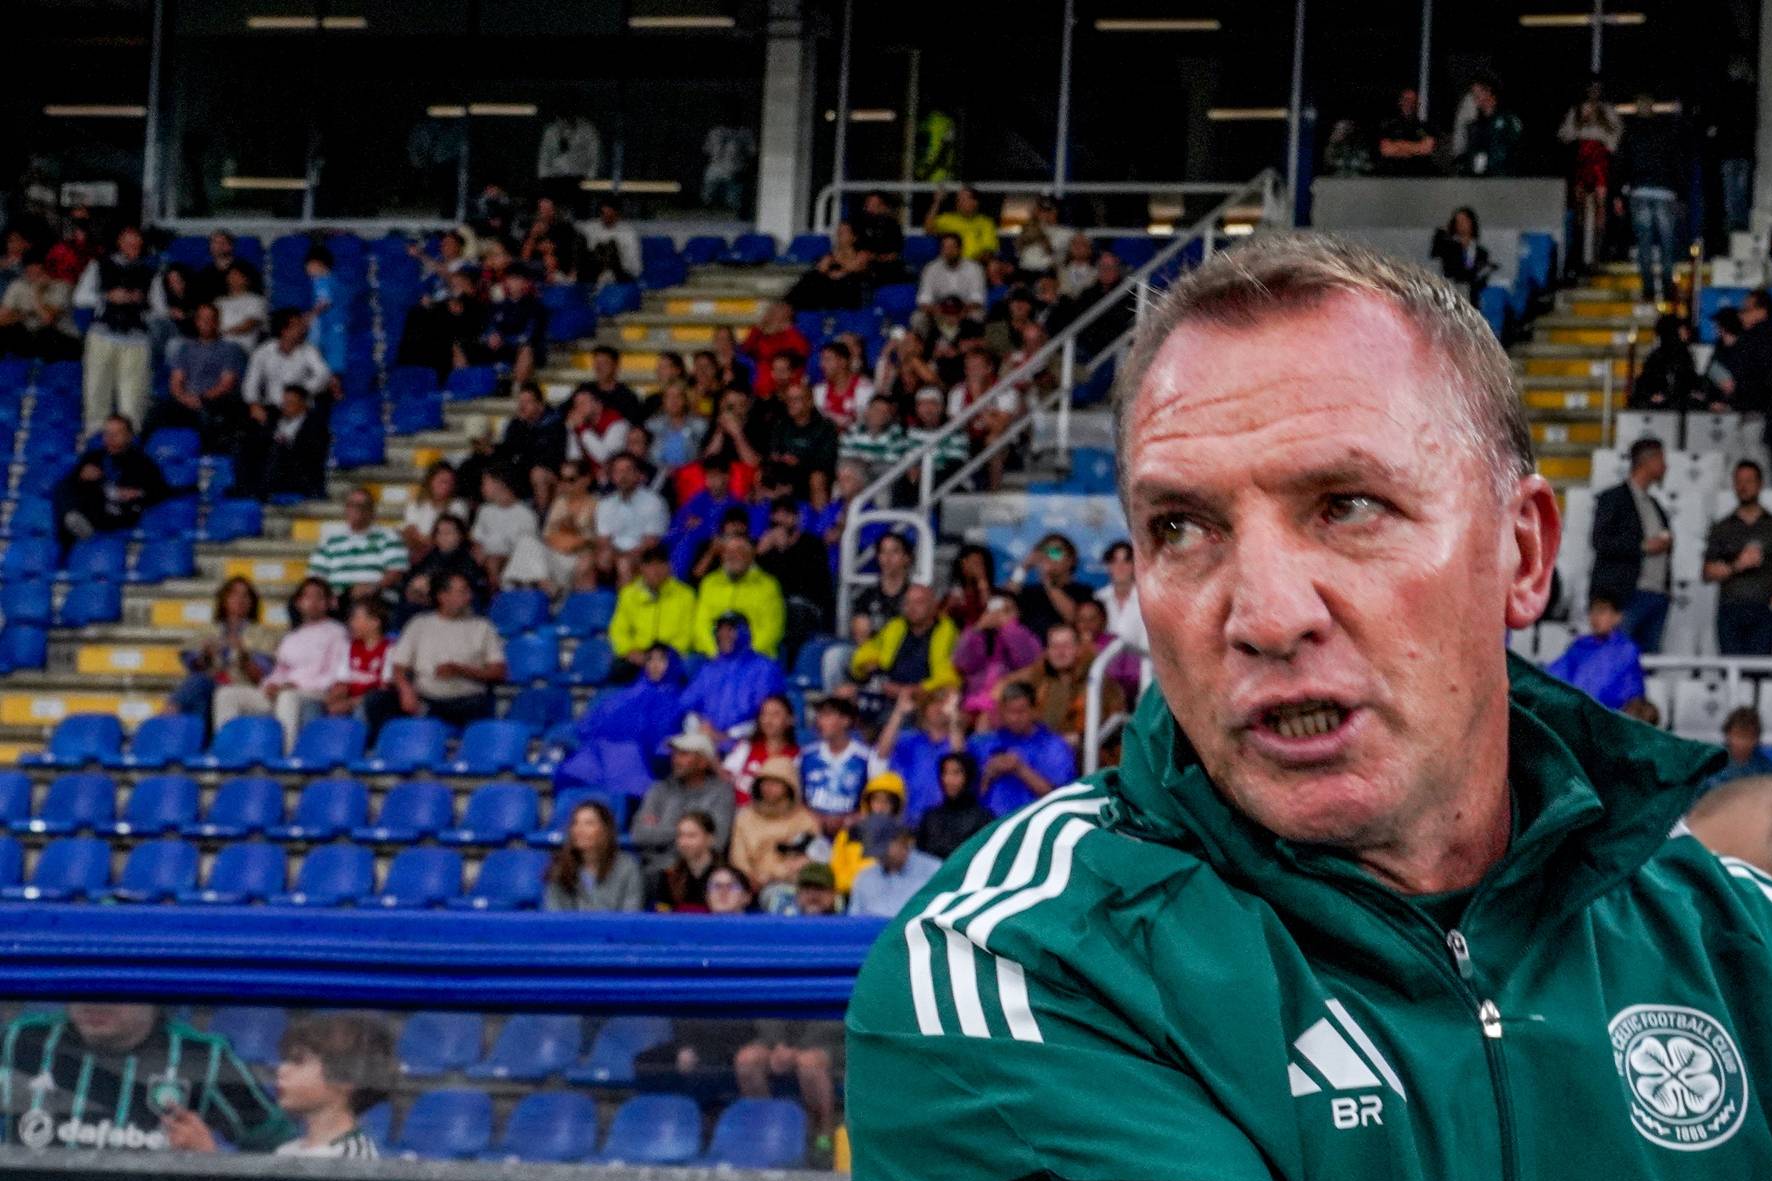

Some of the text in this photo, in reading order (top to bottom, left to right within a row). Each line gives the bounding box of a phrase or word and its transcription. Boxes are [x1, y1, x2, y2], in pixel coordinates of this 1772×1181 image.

[1640, 1011, 1713, 1041] FOOTBALL
[1331, 1094, 1384, 1130] BR
[58, 1119, 166, 1150] dafabe
